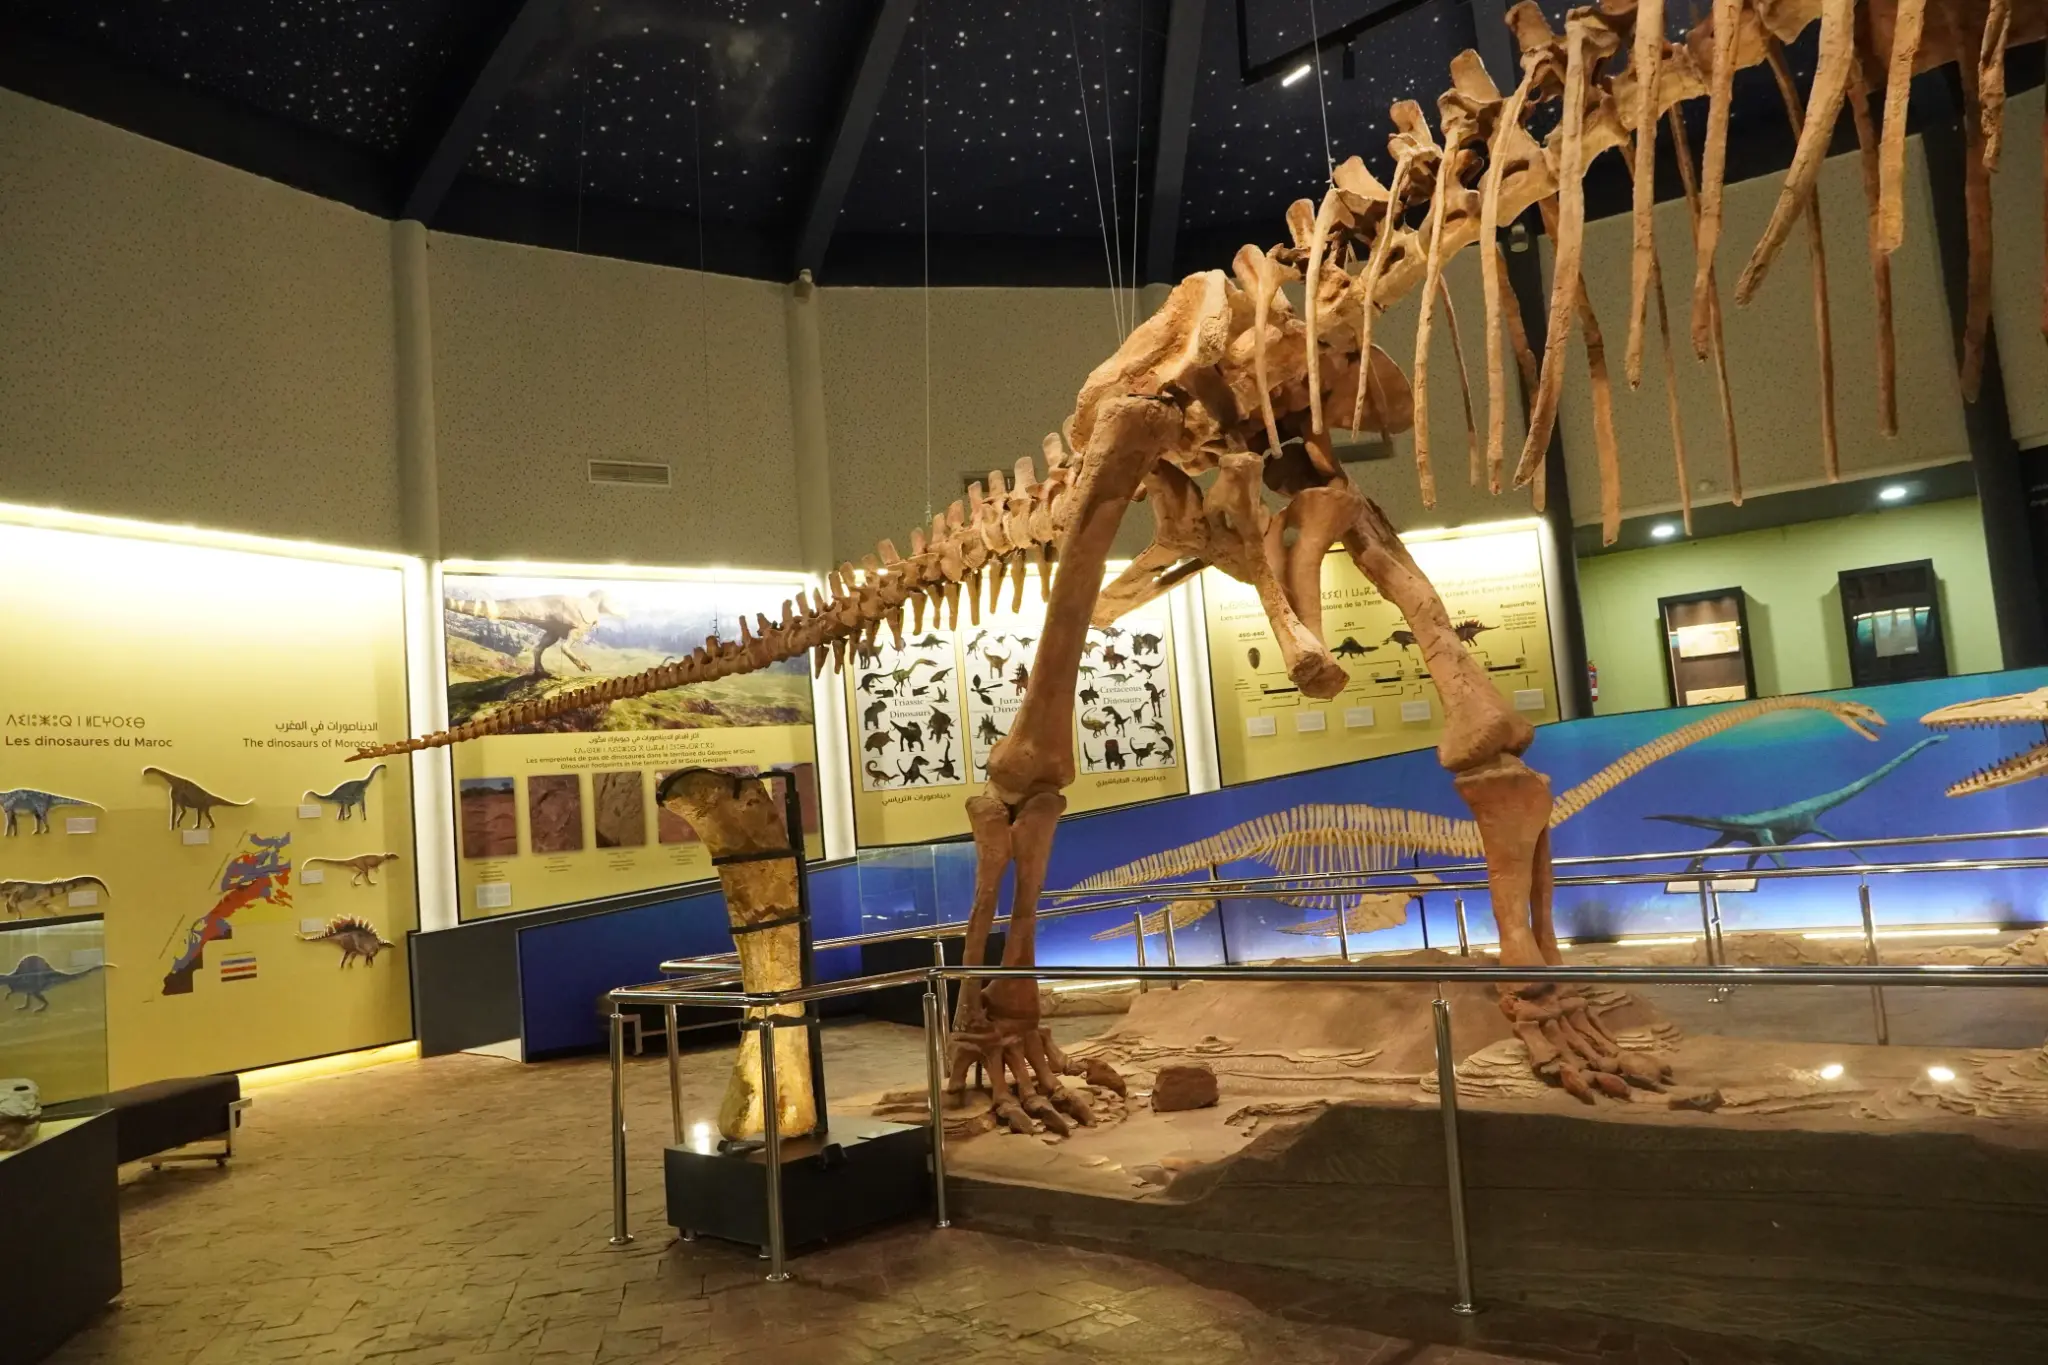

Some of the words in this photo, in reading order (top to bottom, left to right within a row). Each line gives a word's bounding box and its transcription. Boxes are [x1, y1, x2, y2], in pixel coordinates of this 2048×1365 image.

[1100, 685, 1142, 693] Cretaceous
[893, 699, 924, 707] Triassic
[999, 697, 1023, 705] Juras
[1103, 697, 1142, 705] Dinosaurs
[992, 705, 1021, 713] Dinos
[889, 710, 932, 719] Dinosaurs
[275, 720, 307, 732] المغرب
[310, 720, 324, 736] في
[327, 721, 378, 733] الديناصورات
[5, 736, 30, 746] Les
[34, 736, 110, 747] dinosaures
[113, 737, 130, 747] du
[134, 738, 173, 747] Maroc
[243, 738, 264, 748] The
[267, 738, 318, 748] dinosaurs
[321, 739, 332, 748] of
[335, 739, 378, 748] Morocco
[540, 754, 577, 764] empreintes
[588, 754, 600, 763] pas
[611, 751, 645, 760] dinosaures
[647, 751, 661, 759] dans
[561, 761, 590, 769] Dinosaur
[591, 760, 622, 769] footprints
[632, 759, 642, 767] the
[643, 758, 669, 767] territory
